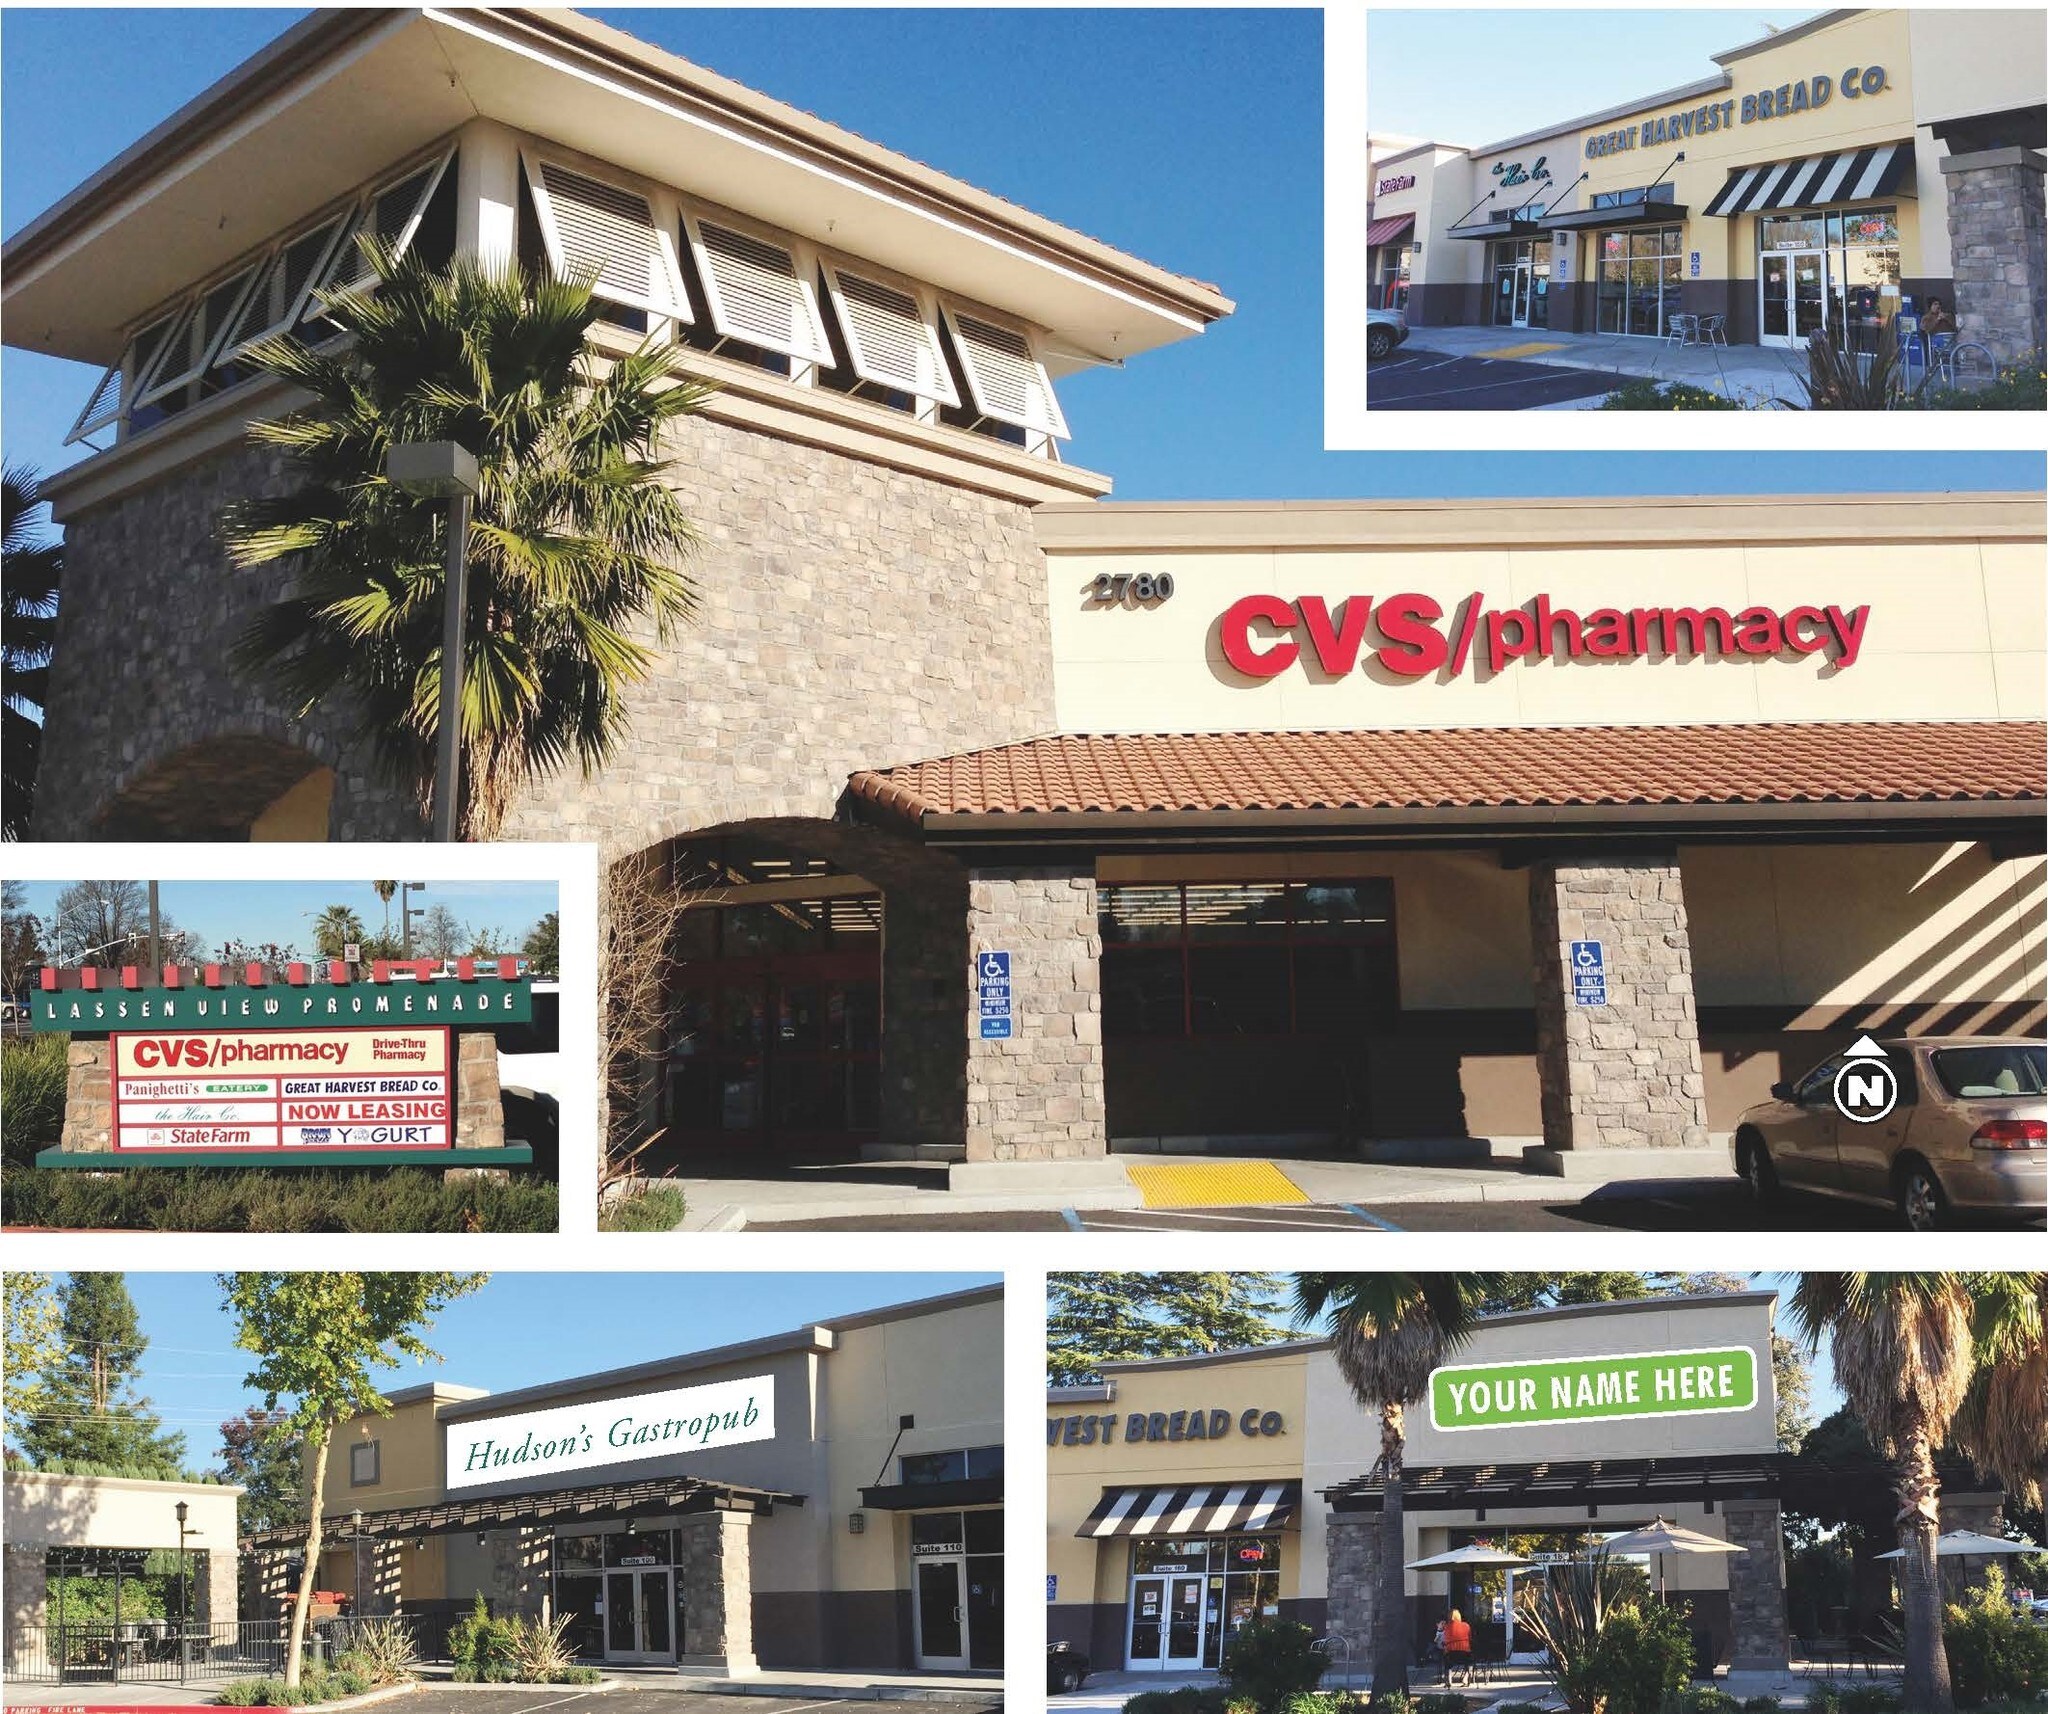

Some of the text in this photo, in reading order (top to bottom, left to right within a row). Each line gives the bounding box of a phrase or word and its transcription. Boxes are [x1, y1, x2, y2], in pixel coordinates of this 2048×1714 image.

[1585, 126, 1637, 160] GREAT
[1641, 99, 1735, 147] HARVEST
[1740, 75, 1832, 125] BREAD
[1094, 572, 1174, 601] 2780
[1221, 591, 1871, 676] CVS/pharmacy
[1574, 966, 1603, 976] PARKING
[980, 977, 1009, 987] PARKING
[1581, 977, 1598, 986] ONLY
[986, 987, 1004, 997] ONLY
[47, 1000, 176, 1019] LASSEN
[303, 992, 513, 1014] PROMENADE
[372, 1038, 426, 1049] Drive-Thru
[133, 1038, 349, 1068] CVS/pharmacy
[373, 1050, 426, 1061] Pharmacy
[125, 1082, 200, 1098] Panighetti's
[285, 1082, 321, 1094] GREAT
[325, 1081, 376, 1093] HARVEST
[380, 1080, 418, 1092] BREAD
[154, 1108, 173, 1121] the
[288, 1103, 446, 1119] NOW LEASING
[1125, 1409, 1231, 1442] BREAD
[464, 1397, 759, 1471] Hudson's Gastropub
[943, 1543, 962, 1551] 110
